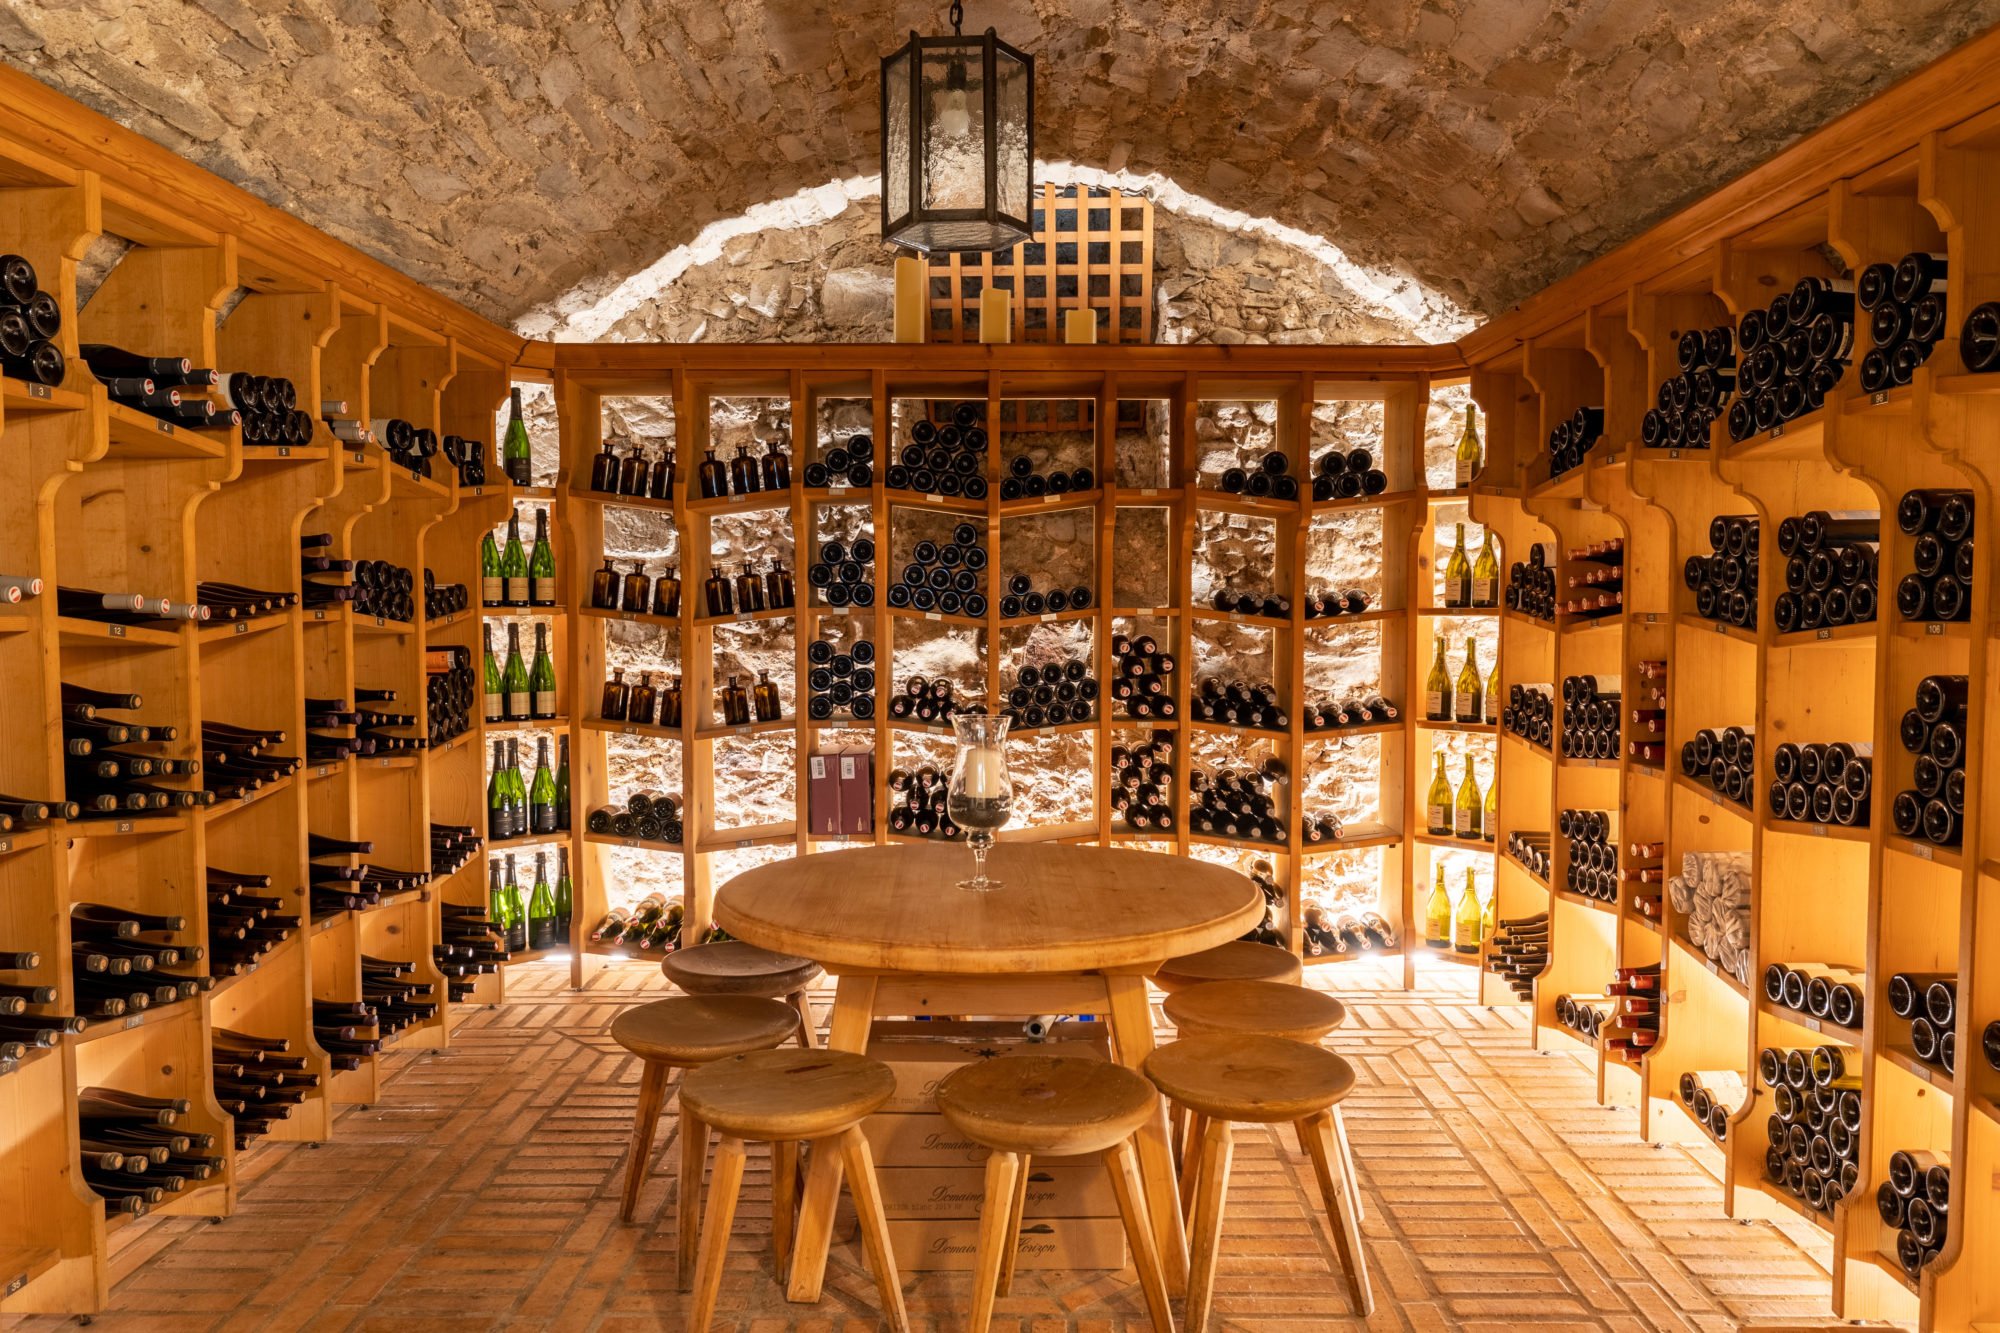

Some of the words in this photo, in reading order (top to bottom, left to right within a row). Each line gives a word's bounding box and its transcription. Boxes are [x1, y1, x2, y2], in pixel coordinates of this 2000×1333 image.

[1929, 624, 1940, 634] 106
[121, 823, 129, 831] 20
[928, 1236, 977, 1255] Domain
[11, 1281, 21, 1292] 35
